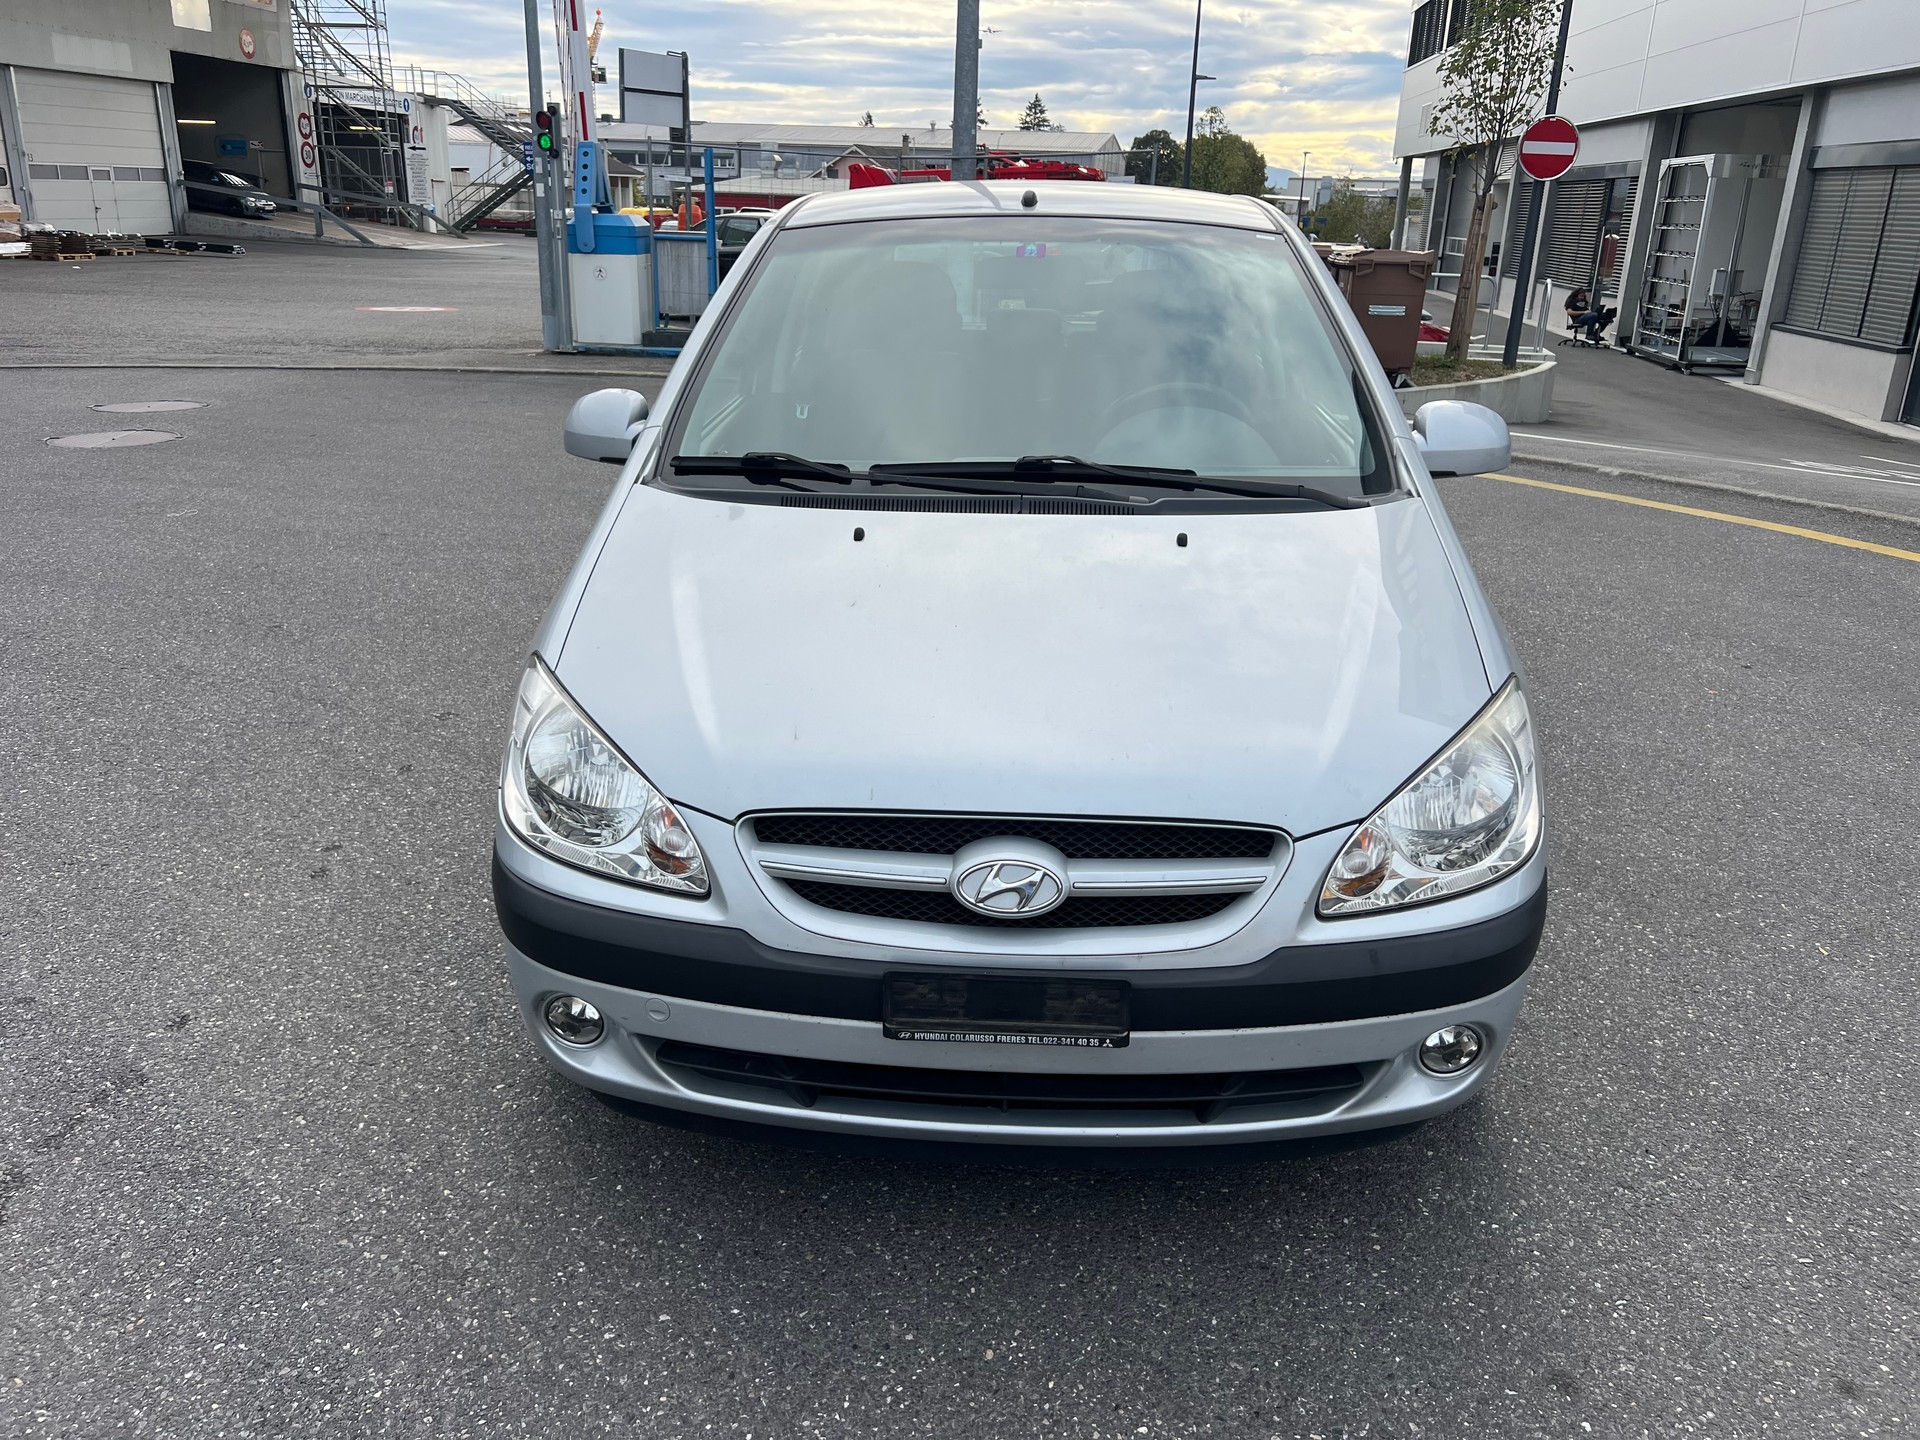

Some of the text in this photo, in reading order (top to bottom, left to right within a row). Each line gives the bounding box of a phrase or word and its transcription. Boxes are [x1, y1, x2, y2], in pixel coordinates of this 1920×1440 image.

[345, 90, 381, 105] MARCHANDSE
[914, 1032, 948, 1041] HYUNDAI
[949, 1033, 994, 1043] COLARUSSO
[997, 1035, 1026, 1044] FRERES
[1077, 1038, 1087, 1046] 40
[1089, 1038, 1099, 1047] 35
